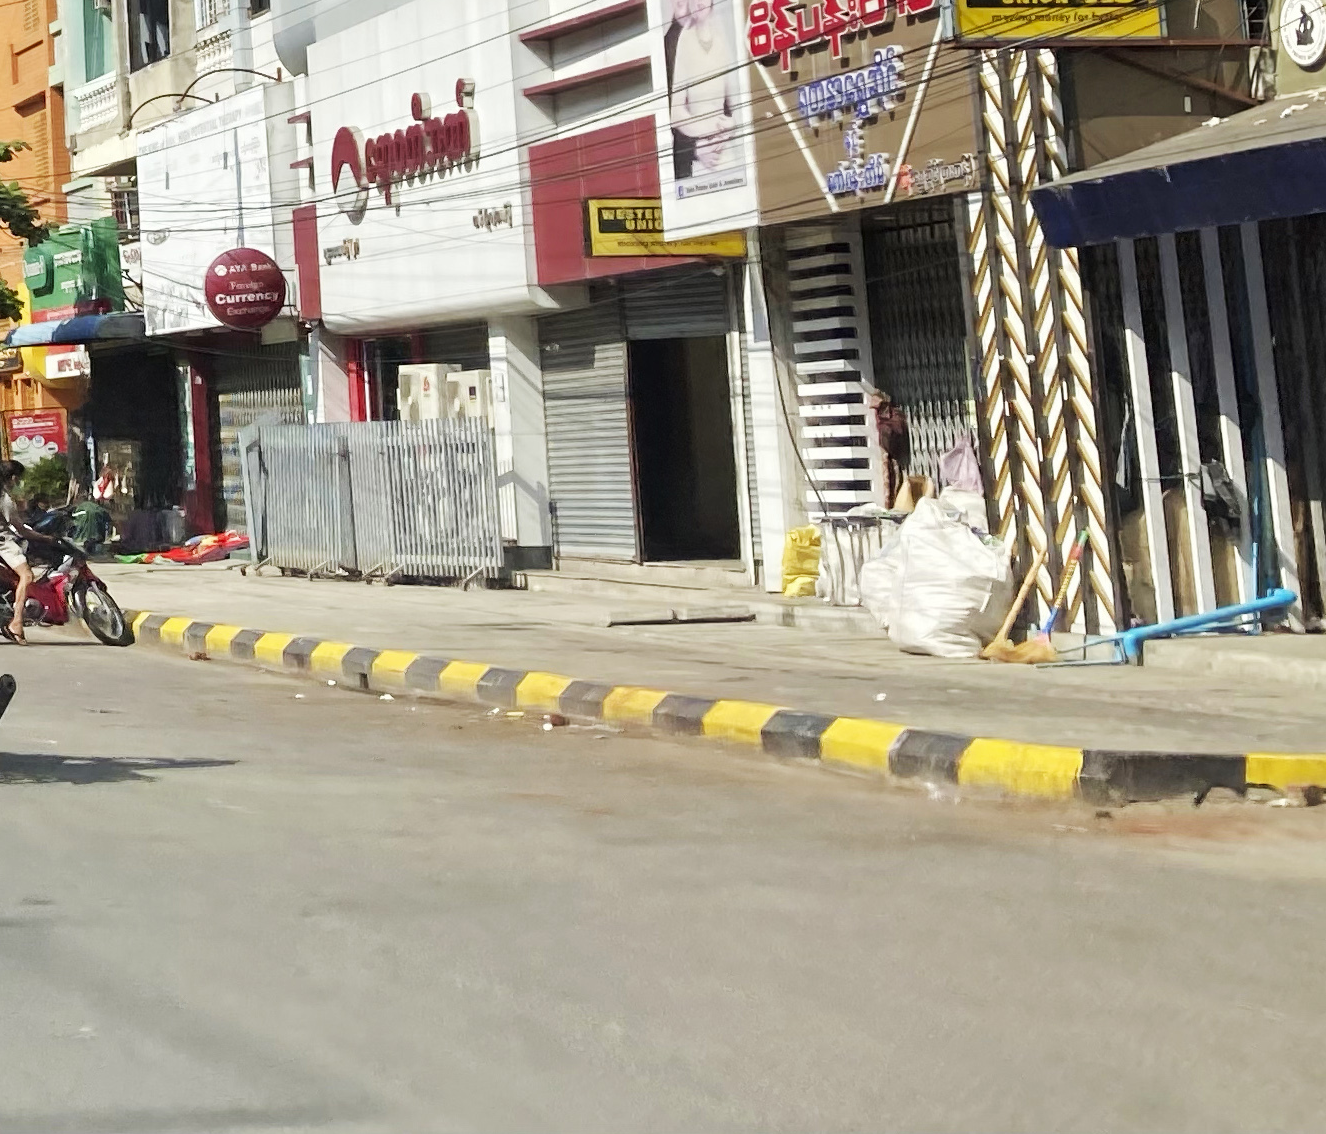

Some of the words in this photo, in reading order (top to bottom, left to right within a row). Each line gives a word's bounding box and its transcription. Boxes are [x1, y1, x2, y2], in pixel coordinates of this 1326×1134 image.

[601, 208, 662, 220] WESTER
[625, 219, 664, 231] UNIO
[229, 264, 247, 274] AYA
[215, 292, 280, 304] Currency
